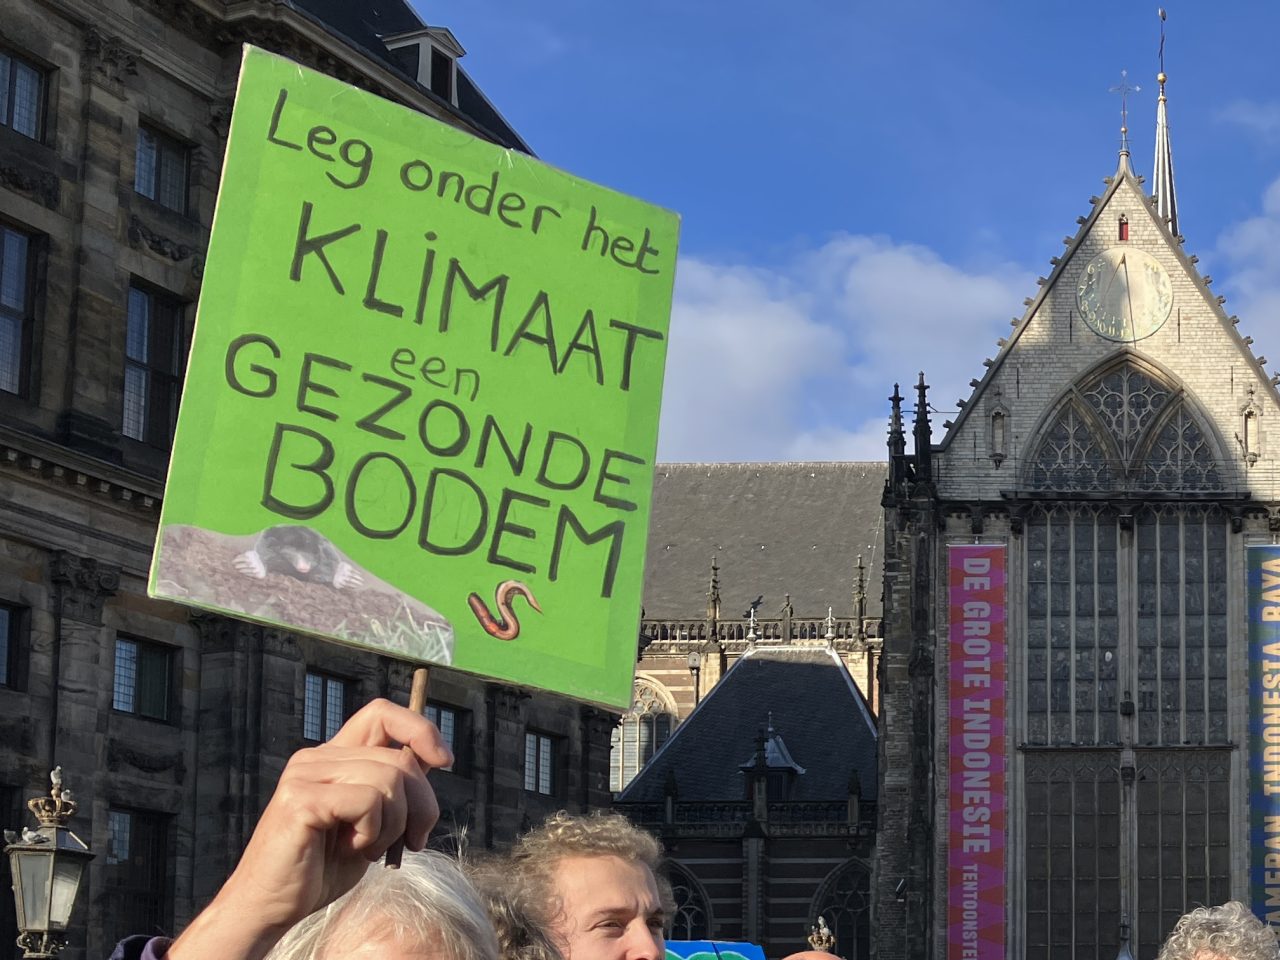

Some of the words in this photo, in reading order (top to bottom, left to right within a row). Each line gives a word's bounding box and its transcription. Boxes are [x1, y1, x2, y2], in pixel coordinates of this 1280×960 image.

[266, 88, 373, 190] Leg
[400, 158, 562, 234] onder
[582, 206, 661, 275] het
[225, 333, 647, 511] GEZONDE
[390, 347, 481, 402] een
[260, 421, 626, 599] BODEM
[963, 557, 991, 591] DE
[963, 602, 991, 688] GROTE
[963, 699, 991, 854] INDONESIE
